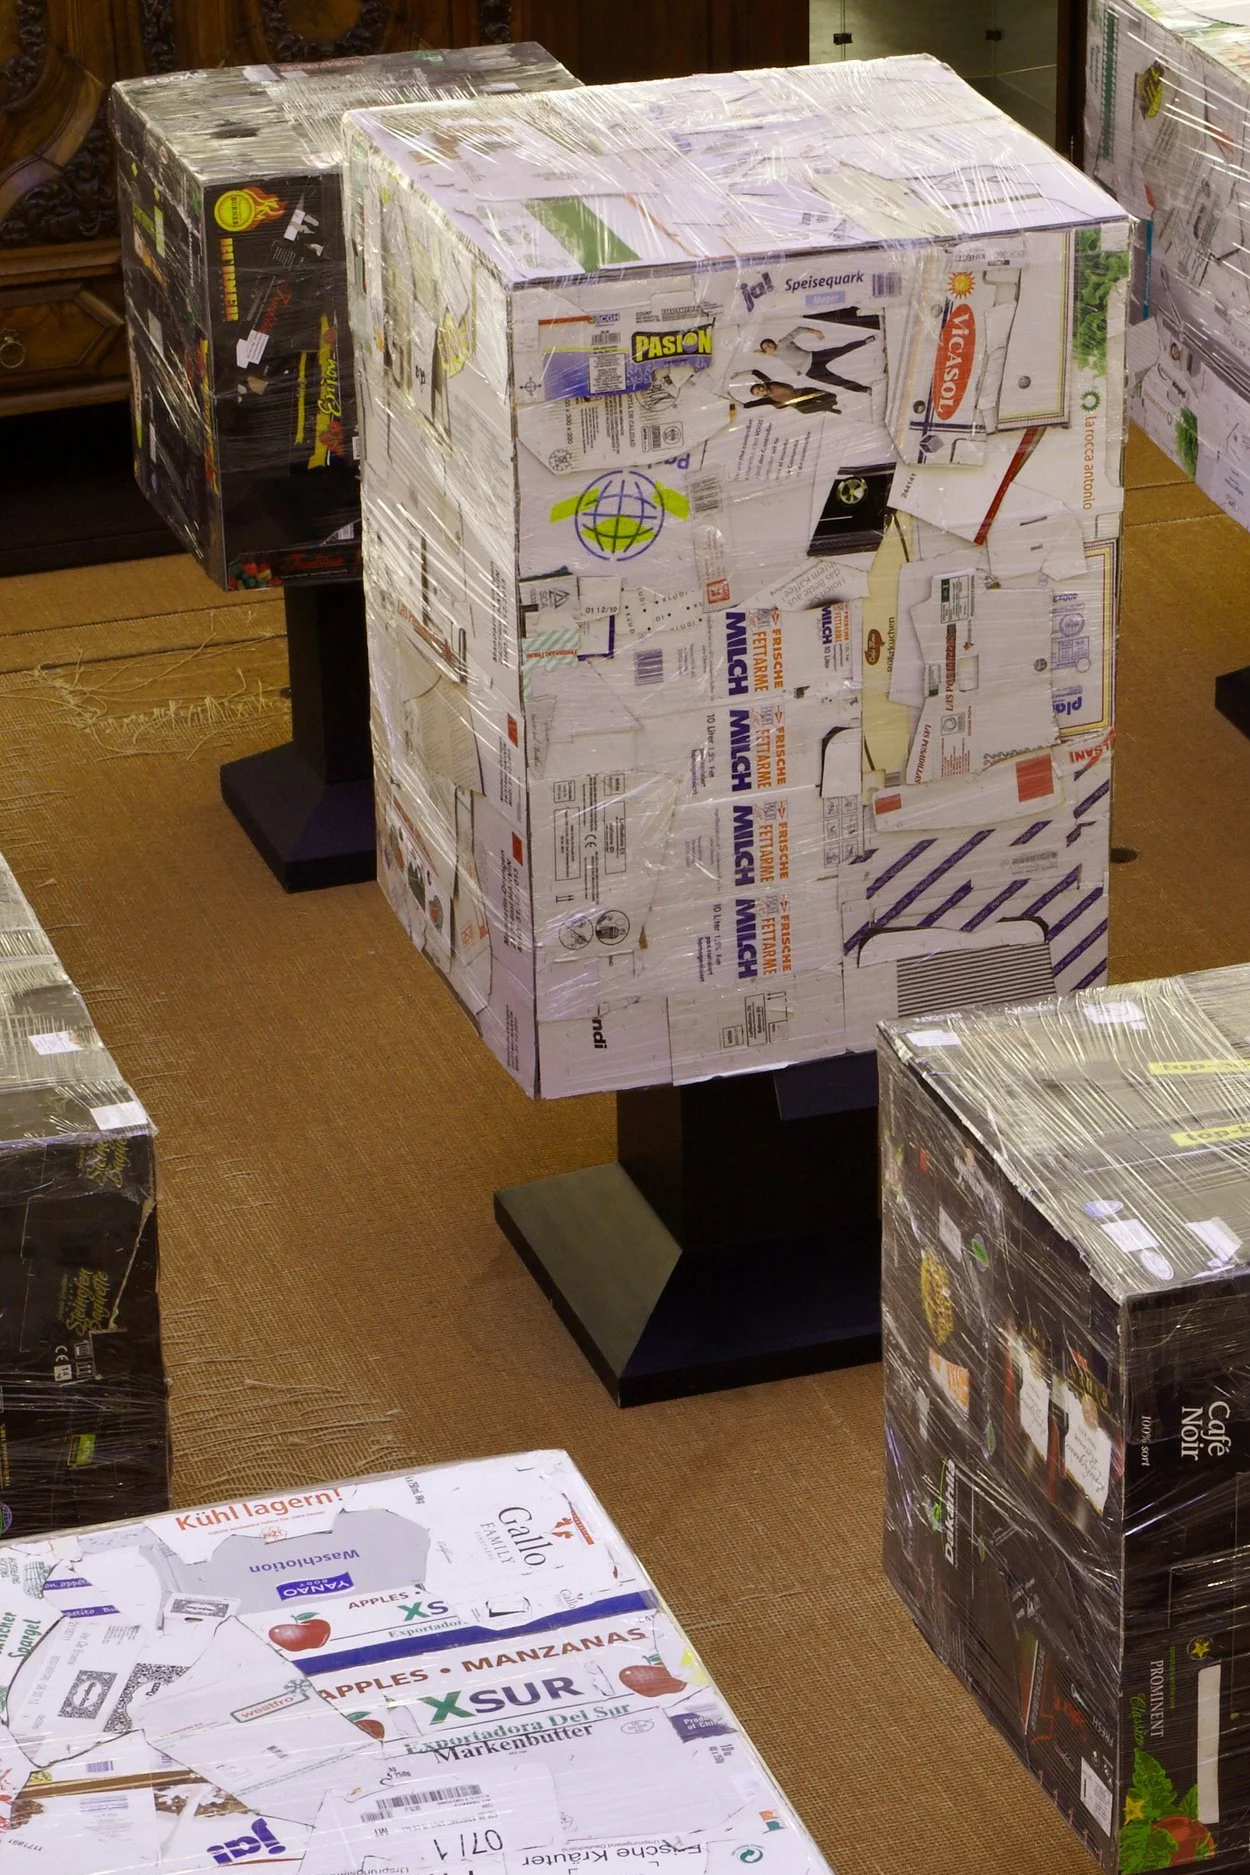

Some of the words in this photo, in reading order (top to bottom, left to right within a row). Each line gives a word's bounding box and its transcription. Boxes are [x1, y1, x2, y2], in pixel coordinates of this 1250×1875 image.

[740, 272, 774, 311] ja!
[783, 271, 865, 291] Speisequark
[1085, 416, 1097, 427] la
[1085, 430, 1094, 461] rocca
[901, 472, 916, 498] 244141
[1083, 464, 1095, 510] antonio
[822, 606, 833, 645] MILCH
[726, 612, 748, 696] MILCH
[753, 630, 769, 693] FETTARME
[772, 629, 784, 689] FRISCHE
[729, 710, 752, 792] MILCH
[756, 728, 772, 789] FETTARME
[776, 727, 787, 785] FRISCHE
[733, 805, 755, 886] MILCH
[759, 824, 774, 883] FETTARME
[778, 822, 789, 879] FRISCHE
[736, 899, 758, 979] MILCH
[761, 917, 777, 976] FETTARME
[780, 915, 792, 972] FRISCHE
[1141, 1414, 1152, 1445] 100%
[1180, 1405, 1204, 1461] Noir
[1207, 1400, 1232, 1458] Café
[175, 1504, 240, 1532] Kühl
[243, 1488, 344, 1524] lagern!
[248, 1548, 360, 1574] Waschlotion
[479, 1522, 517, 1566] FAMILY
[498, 1504, 547, 1570] Gallo
[282, 1576, 351, 1598] YANAO
[348, 1591, 410, 1610] APPLES
[7, 1619, 42, 1660] Spargel
[461, 1627, 647, 1673] MANZANAS
[418, 1676, 585, 1726] XSUR
[1149, 1659, 1165, 1739] PROMINENT
[404, 1720, 544, 1756] Exportadora
[549, 1711, 589, 1725] Del
[594, 1703, 631, 1720] Sur
[434, 1724, 594, 1765] Markenbutter
[206, 1817, 286, 1866] ja!
[521, 1850, 610, 1869] Kräuter
